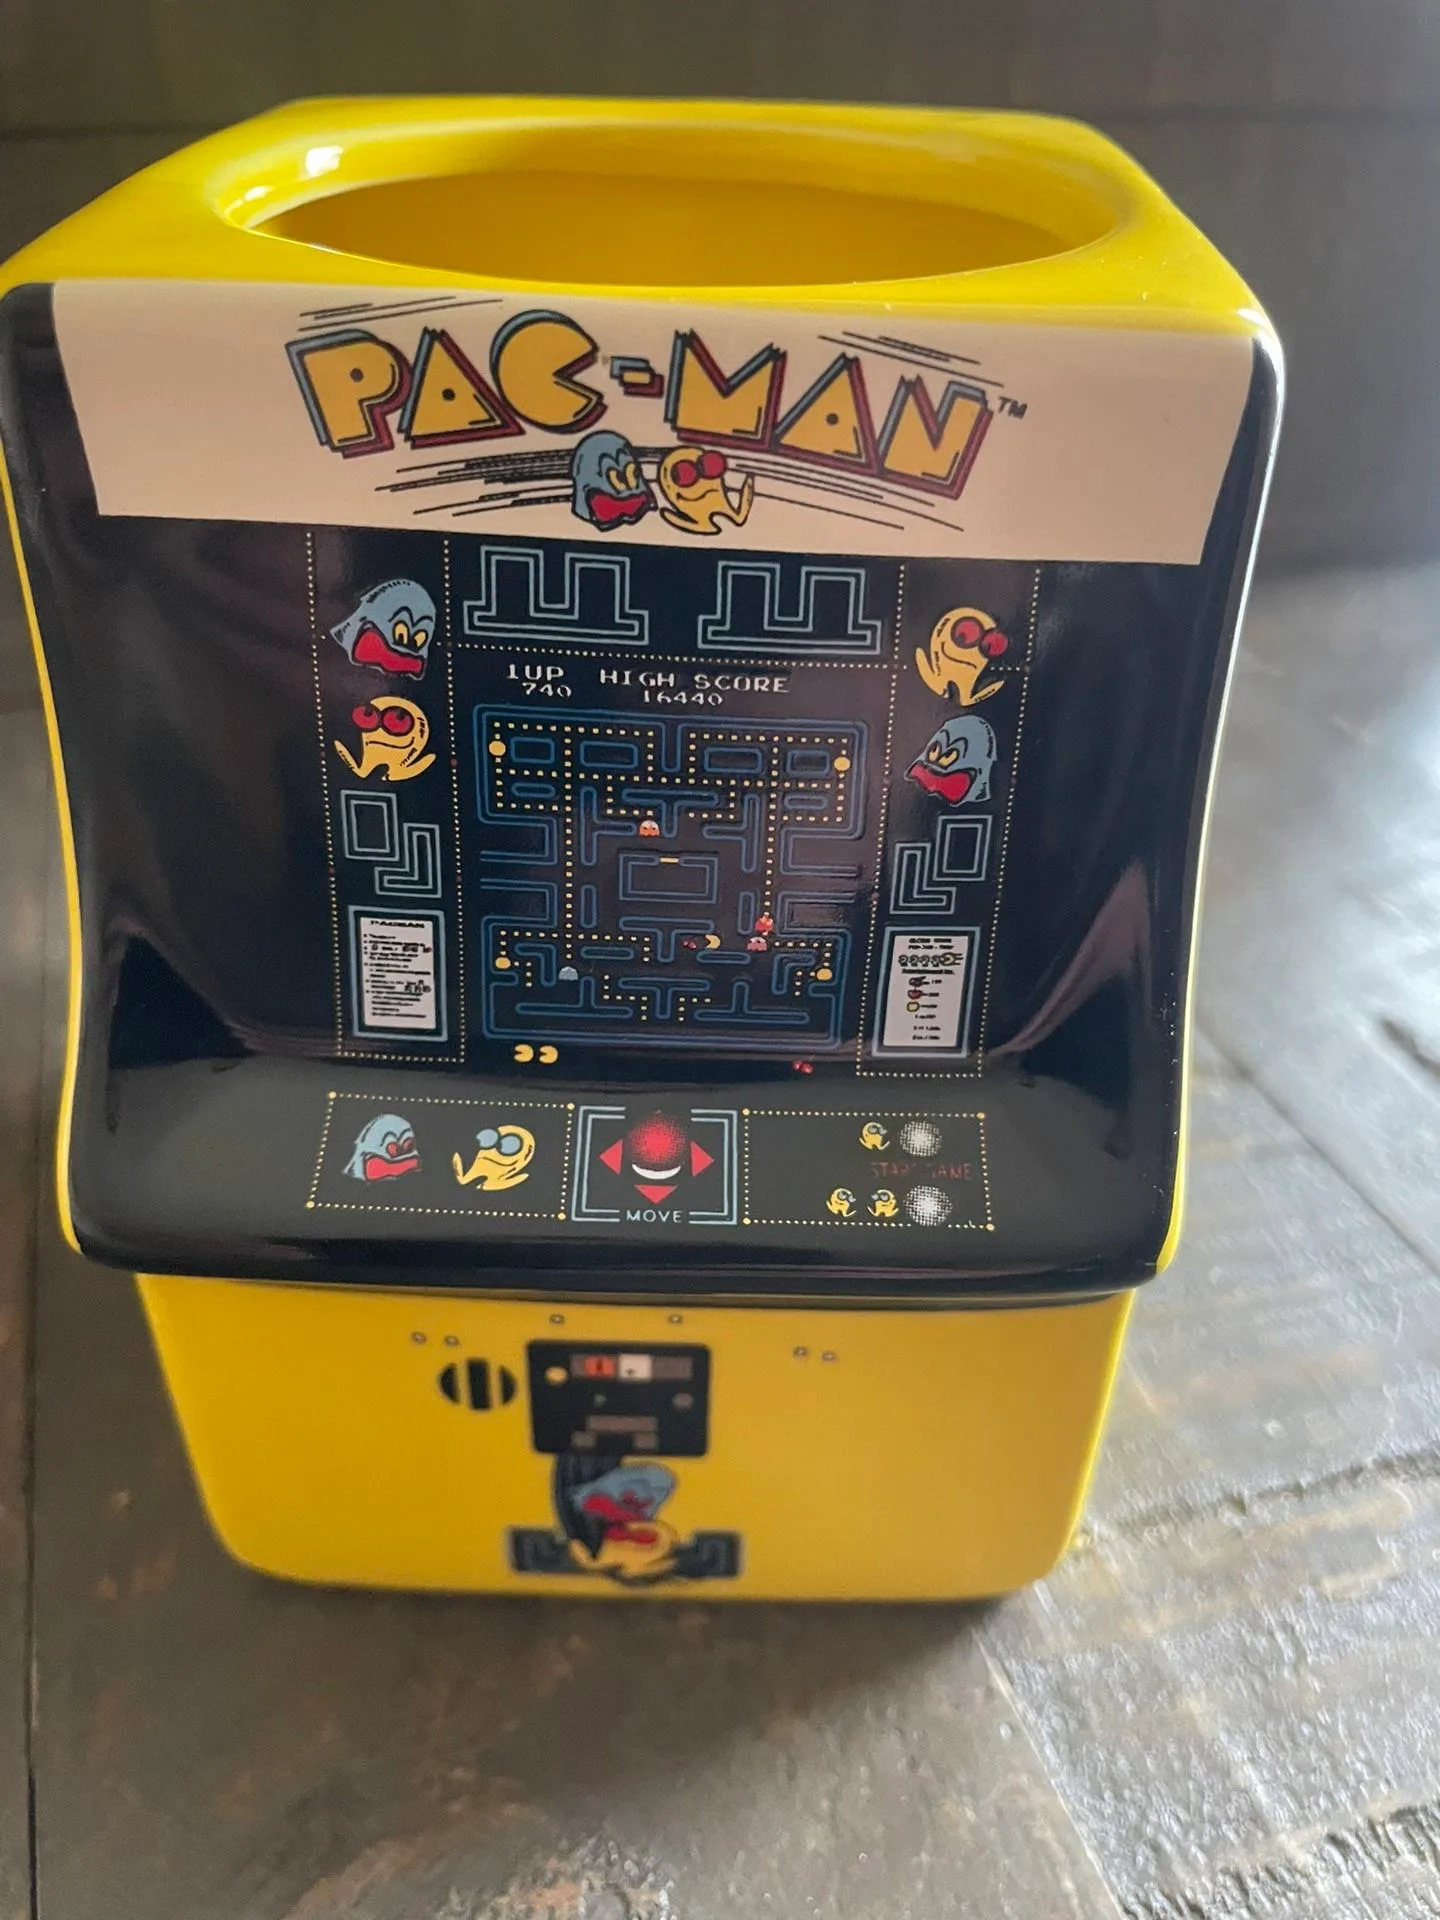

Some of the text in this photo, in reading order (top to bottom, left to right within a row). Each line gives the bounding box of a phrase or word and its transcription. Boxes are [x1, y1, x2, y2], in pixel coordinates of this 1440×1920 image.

[285, 309, 994, 500] PAC-MAN
[506, 663, 791, 694] 1UP HIGH SCORE
[521, 681, 724, 706] 740 16440
[626, 1209, 683, 1223] MOVE
